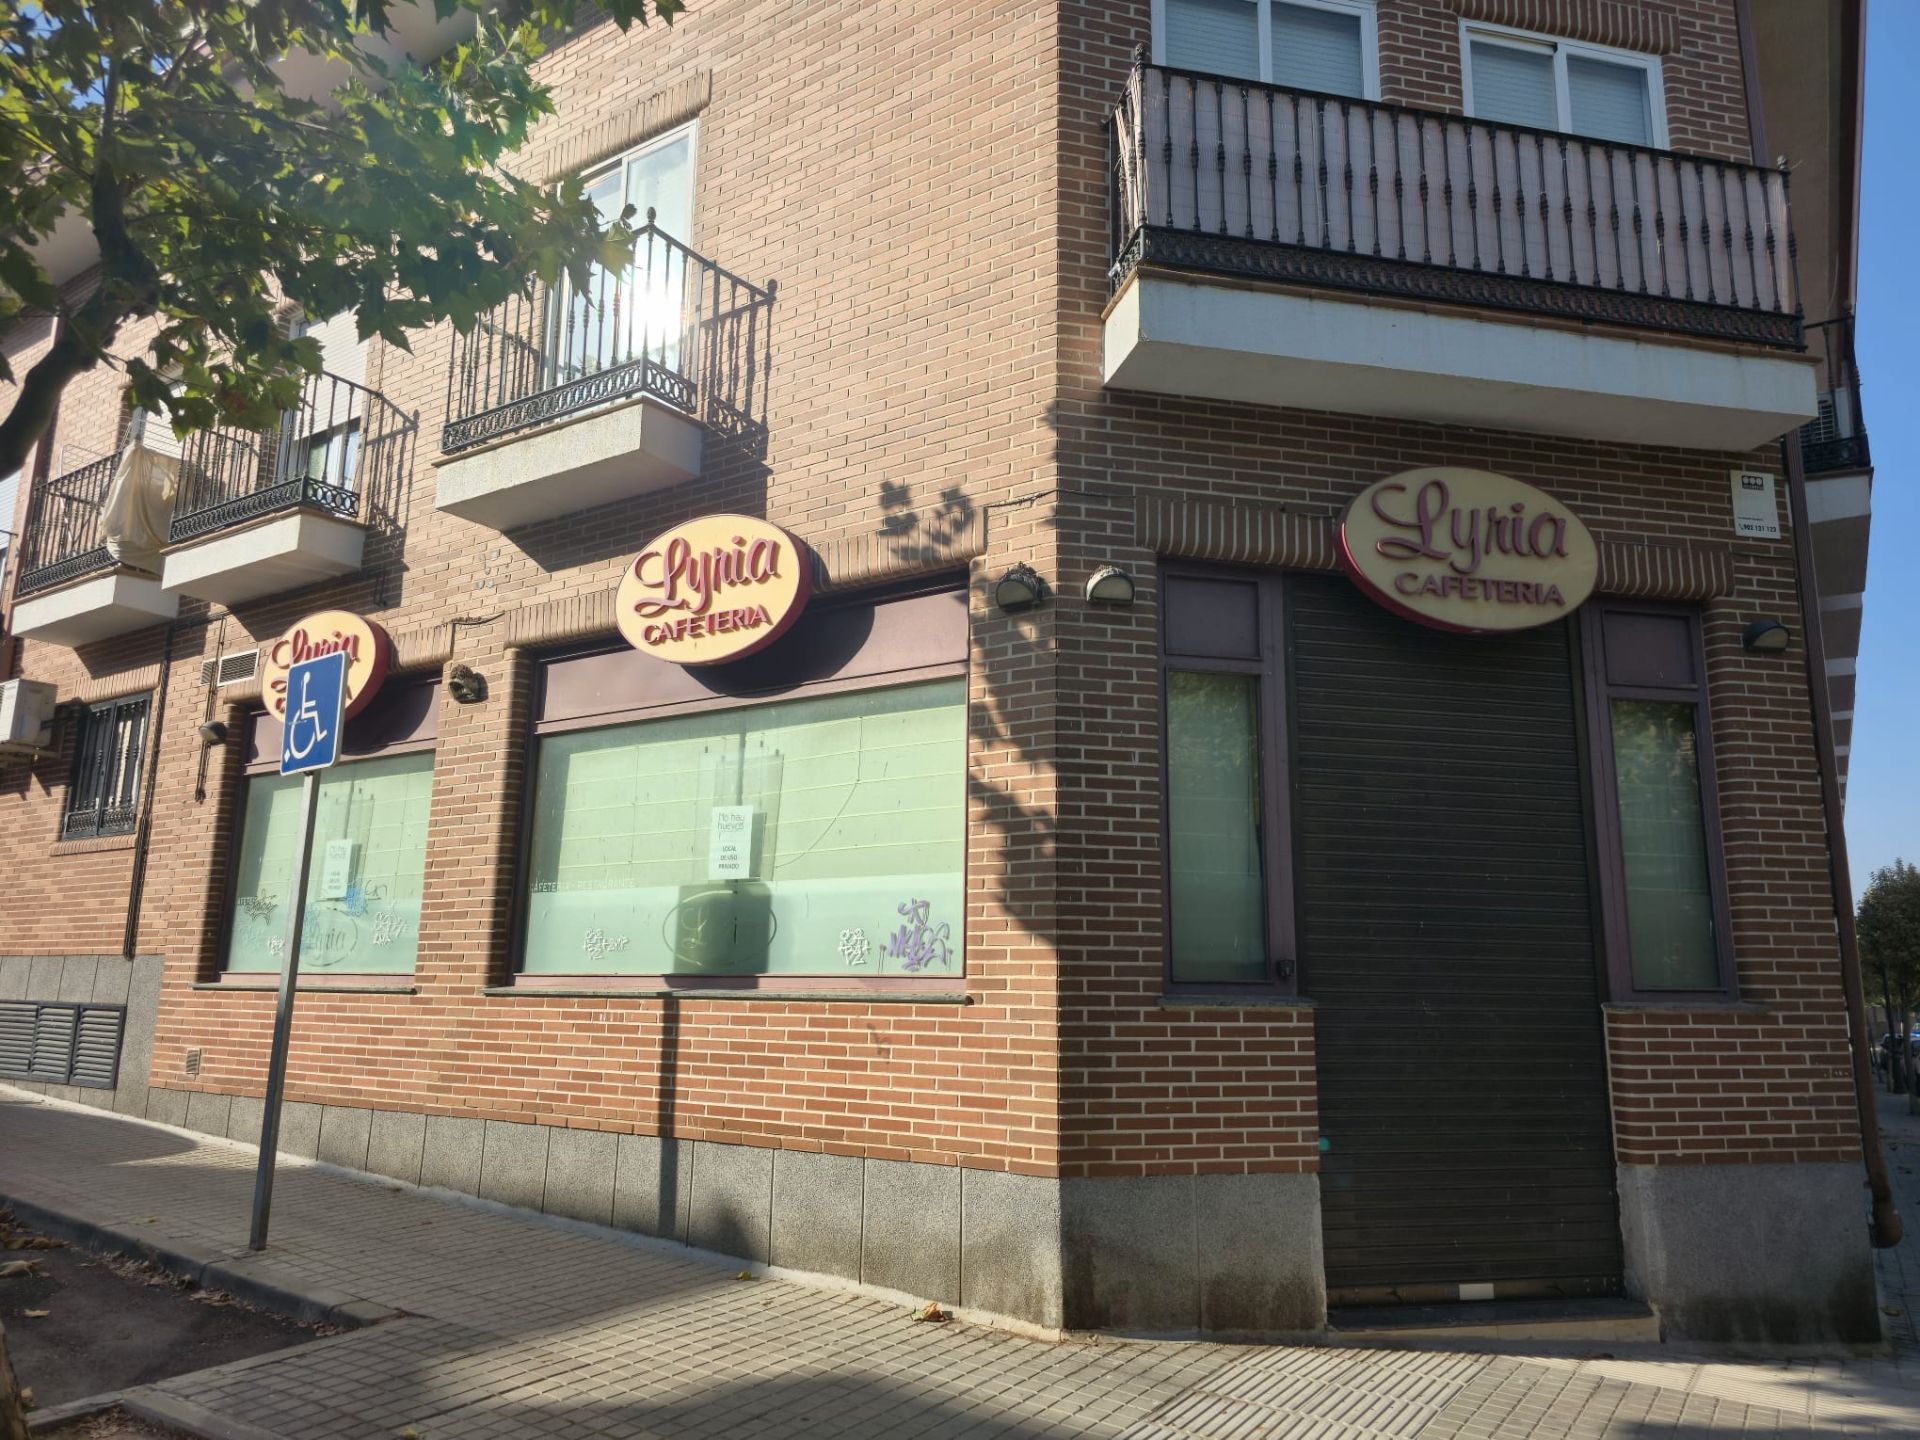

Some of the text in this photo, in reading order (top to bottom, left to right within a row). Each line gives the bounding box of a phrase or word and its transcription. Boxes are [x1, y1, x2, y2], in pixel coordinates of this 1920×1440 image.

[1371, 479, 1568, 573] Lyria
[634, 536, 780, 616] Lyria
[1395, 572, 1566, 606] CAFETERIA
[641, 605, 773, 644] CAFETERIA
